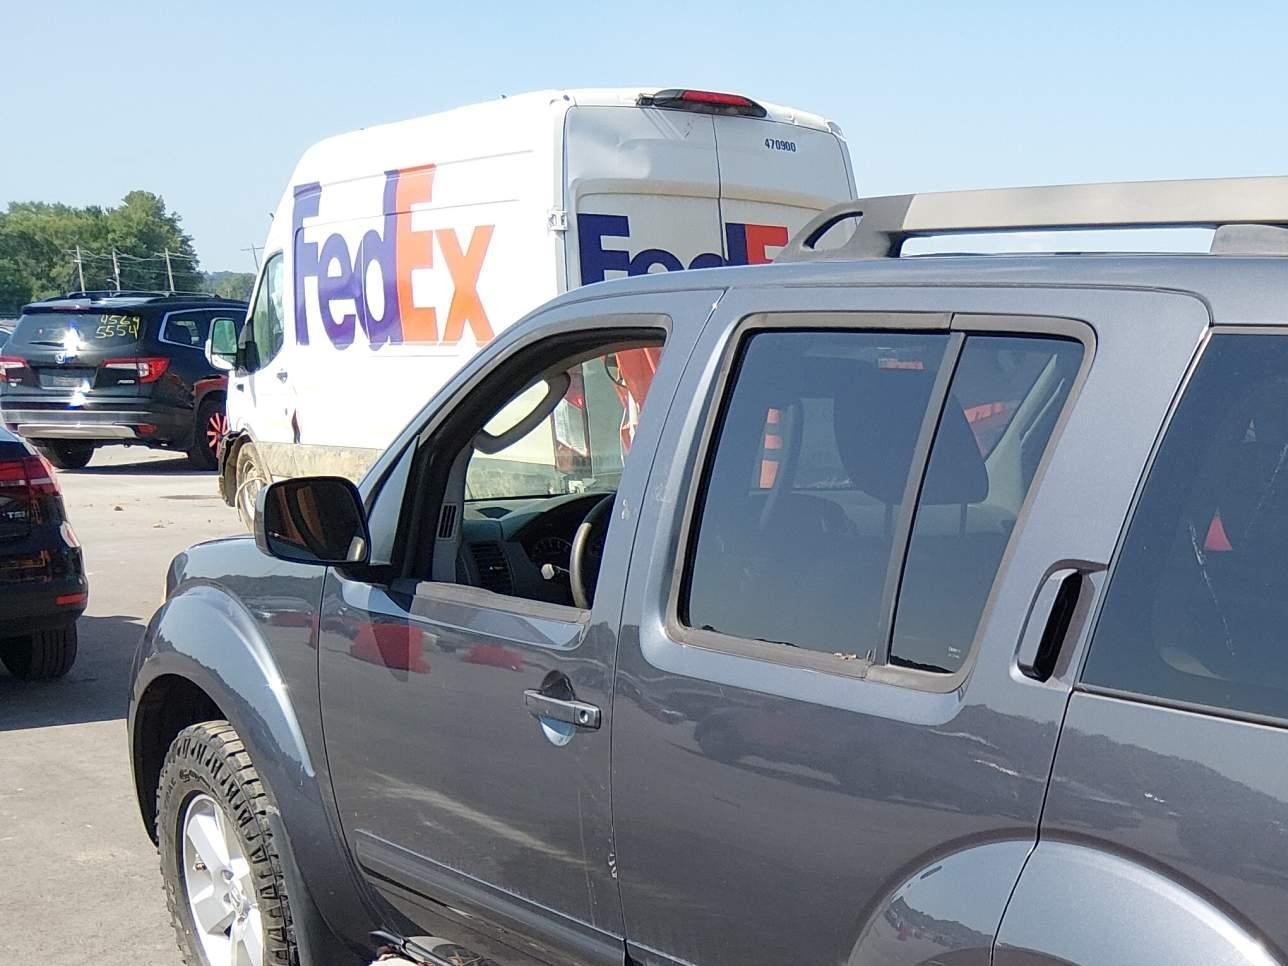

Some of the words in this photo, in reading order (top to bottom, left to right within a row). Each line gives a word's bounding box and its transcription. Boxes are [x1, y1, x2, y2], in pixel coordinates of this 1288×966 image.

[764, 138, 797, 152] 470900
[293, 163, 496, 351] FedEx
[95, 324, 138, 339] 5554
